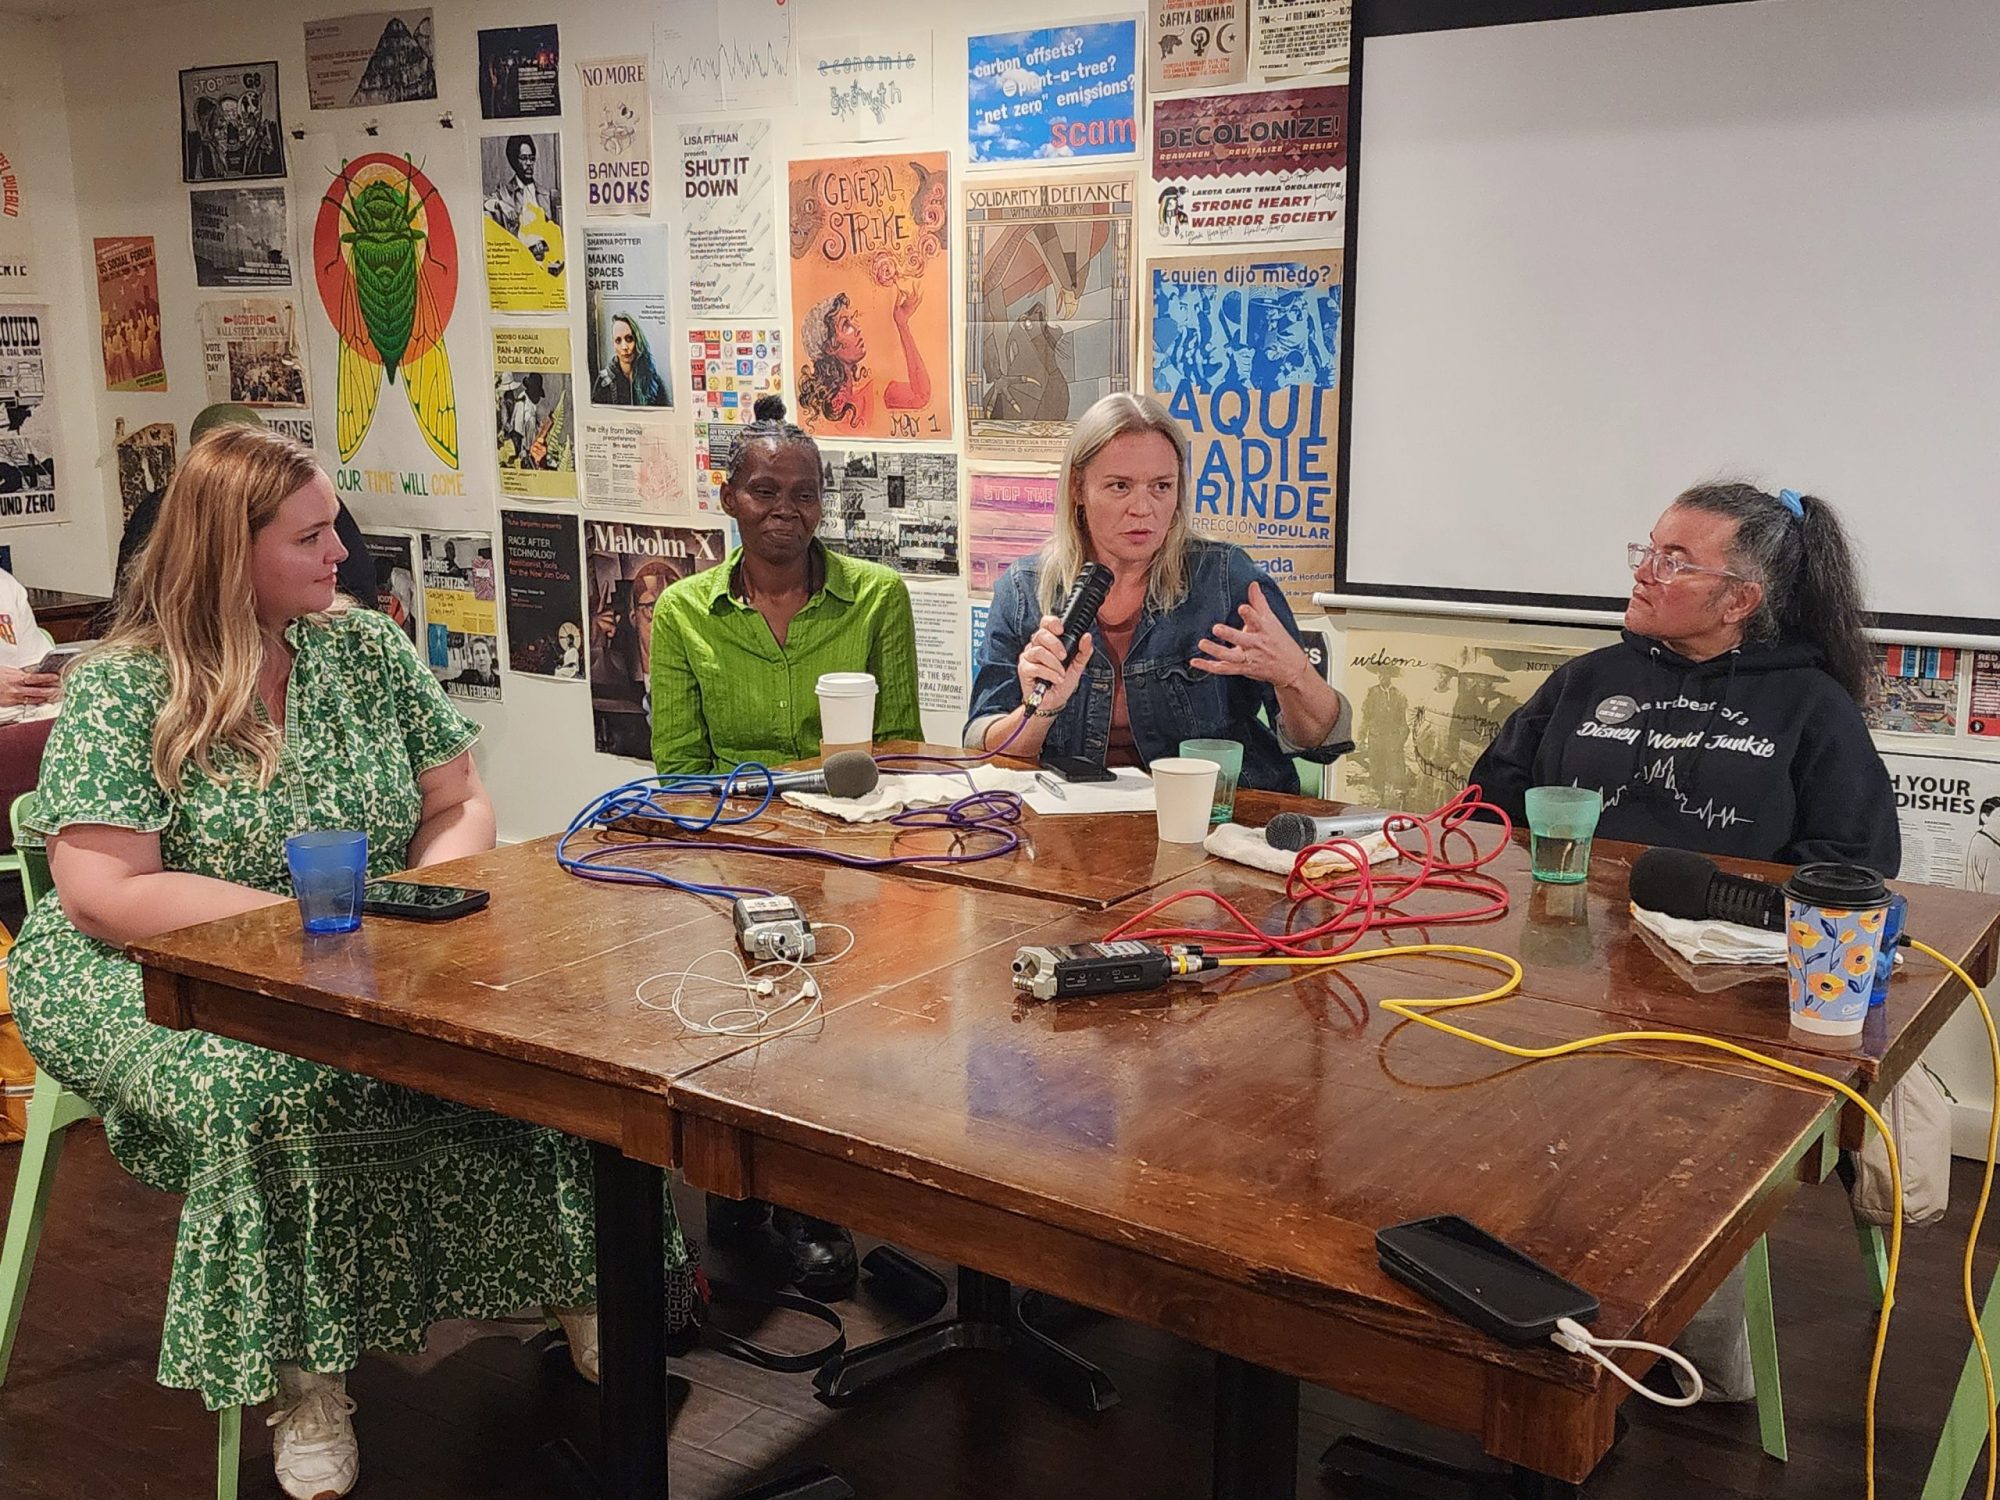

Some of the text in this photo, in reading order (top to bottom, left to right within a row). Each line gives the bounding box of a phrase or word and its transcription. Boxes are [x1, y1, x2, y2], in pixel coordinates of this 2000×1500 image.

[1159, 11, 1192, 27] SAFIYA
[1194, 5, 1235, 24] BUKHARI
[974, 37, 1084, 79] carbon offsets?
[582, 64, 646, 87] NO MORE
[1018, 55, 1117, 97] plant-a-tree?
[1056, 74, 1136, 107] emissions?
[683, 133, 739, 146] LISA FITHIAN
[1051, 118, 1136, 148] scam
[1159, 115, 1341, 149] DECOLONIZE!
[1159, 142, 1339, 161] REAWAKEN REVITALIZE RESIST
[588, 161, 650, 180] BANNED
[684, 157, 749, 178] SHUT IT
[588, 180, 650, 205] BOOKS
[685, 178, 739, 199] DOWN
[823, 165, 905, 208] GENERAL
[1192, 188, 1223, 197] LAKOTA
[1225, 186, 1251, 195] CANTE
[969, 182, 1129, 212] SOLIDARITY DEFIANCE
[1191, 195, 1312, 213] STRONG HEART
[1009, 203, 1085, 218] WITH GRAND JURY
[1191, 210, 1338, 228] WARRIOR SOCIETY
[614, 238, 642, 246] POTTER
[822, 206, 910, 261] STRIKE
[587, 253, 625, 265] MAKING
[588, 267, 624, 278] SPACES
[1160, 265, 1331, 287] ¿quién dijo miedo?
[588, 280, 619, 291] SAFER
[233, 315, 266, 325] OCCUPIED
[0, 315, 41, 347] OUND
[206, 343, 221, 352] VOTE
[497, 346, 545, 355] PAN-AFRICAN
[206, 353, 226, 362] EVERY
[497, 355, 560, 366] SOCIAL ECOLOGY
[207, 363, 219, 372] DAY
[1168, 378, 1328, 439] AQUI
[264, 420, 313, 441] IONS
[890, 413, 942, 437] MAY 1
[1186, 436, 1329, 482] ADIE
[336, 469, 466, 496] OUR TIME WILL COME
[983, 485, 1053, 502] STOP THE
[1195, 479, 1332, 524] RINDE
[0, 493, 56, 516] UND ZERO
[507, 535, 551, 548] RACE AFTER
[592, 522, 718, 561] Malcolm X
[508, 547, 557, 560] TECHNOLOGY
[424, 559, 450, 573] GEORGE
[1304, 647, 1322, 665] S
[1350, 647, 1428, 669] welcome
[1976, 661, 1990, 669] 30
[1978, 653, 1998, 662] RED
[927, 671, 940, 680] THE
[941, 672, 956, 681] 99%
[1525, 661, 1551, 672] NOT
[447, 682, 502, 700] SILVIA FEDERICI
[1721, 707, 1744, 721] of
[1737, 717, 1750, 726] a
[1577, 721, 1776, 758] Disney World Junkie
[1907, 775, 1971, 796] YOUR
[1894, 792, 1976, 815] DISHES
